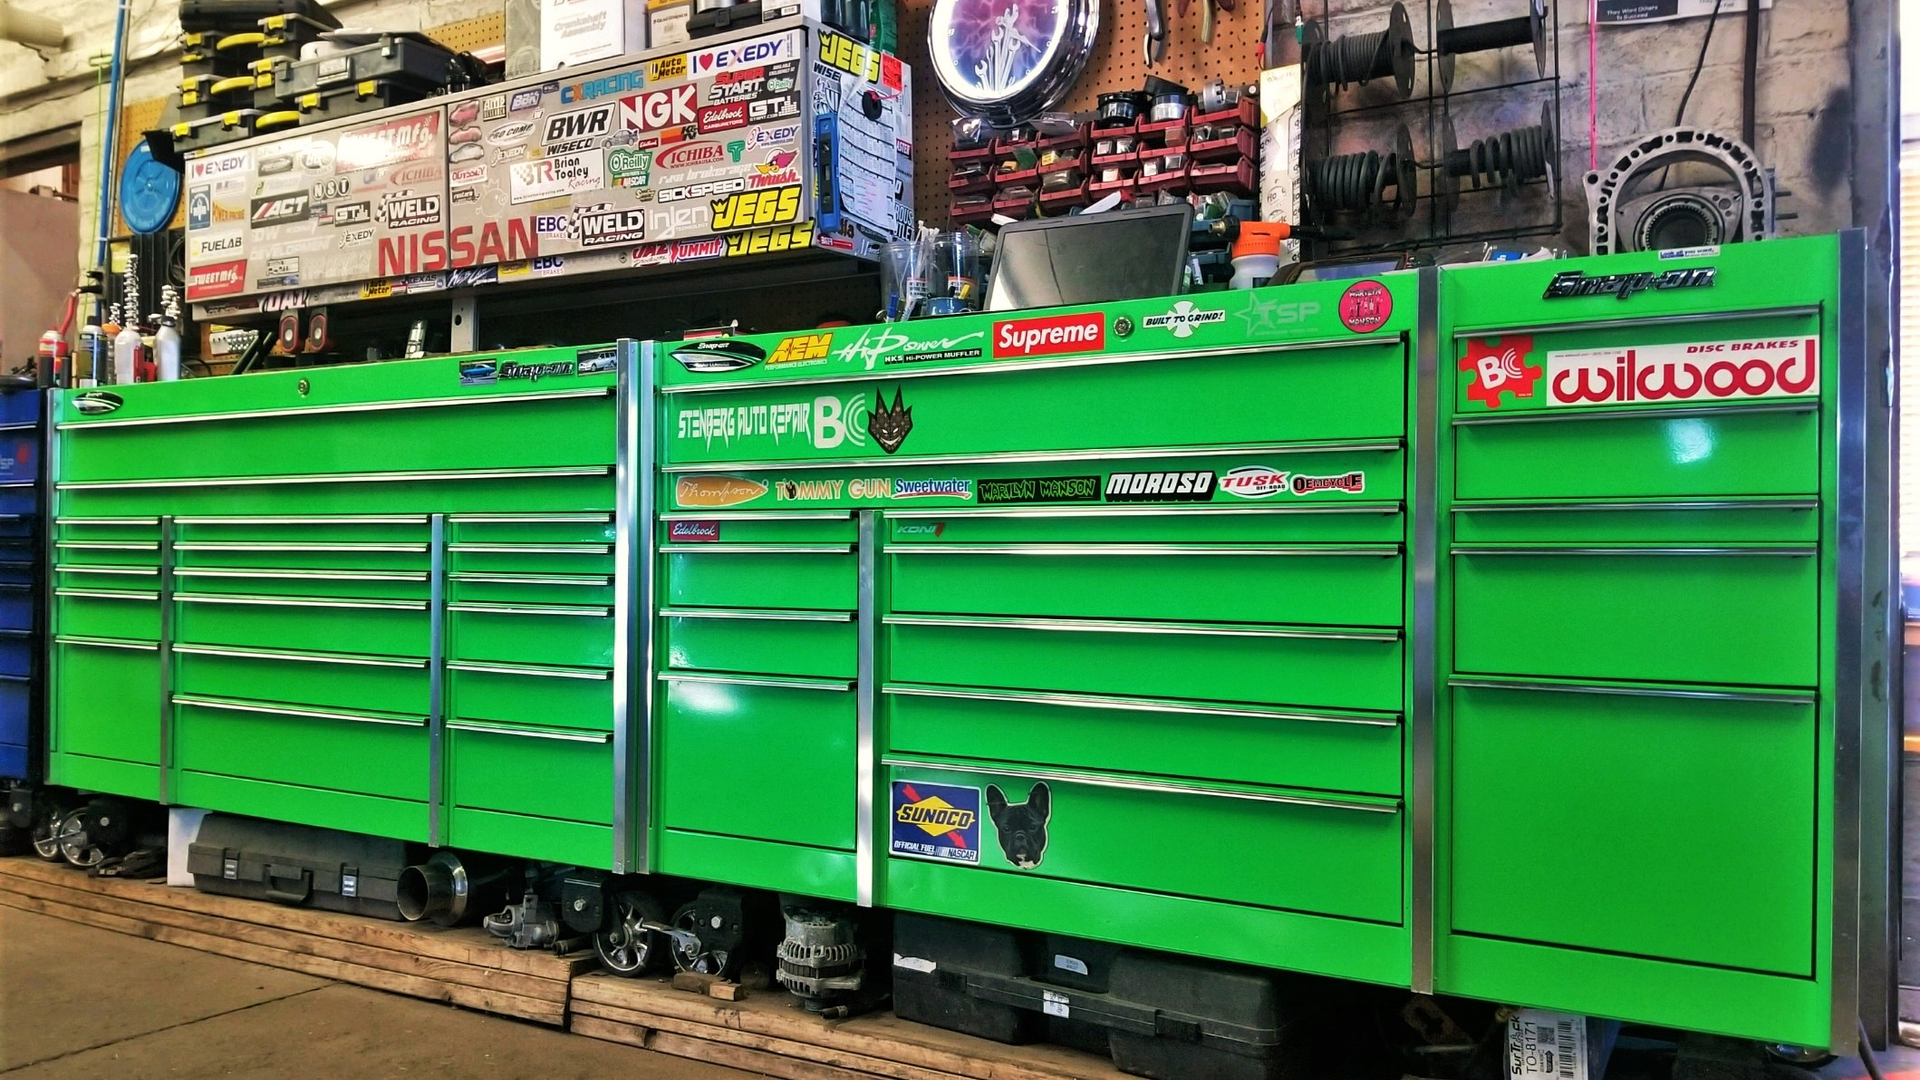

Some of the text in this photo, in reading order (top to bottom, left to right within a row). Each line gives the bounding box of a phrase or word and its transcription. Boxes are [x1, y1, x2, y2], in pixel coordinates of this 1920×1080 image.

[554, 10, 608, 32] Crankshaft
[560, 21, 606, 39] Assembly
[659, 57, 682, 69] Auto
[692, 56, 698, 74] I
[716, 38, 784, 68] EXEDY
[819, 32, 881, 84] JEGS
[658, 65, 687, 80] Meter
[715, 66, 765, 84] SUPER
[814, 62, 841, 82] WISE
[561, 69, 644, 104] CXRACING
[708, 78, 765, 100] START
[483, 94, 506, 111] AMP
[619, 84, 697, 132] NGK
[714, 92, 758, 106] BATTERIES
[702, 106, 743, 124] Edelbrock
[506, 123, 534, 138] COMP
[546, 108, 610, 142] BWR
[756, 126, 799, 142] EXEDY
[499, 144, 527, 160] EXEDY
[546, 138, 595, 156] WISECO
[671, 145, 724, 164] ICHIBA
[205, 155, 245, 175] EXEDY
[554, 156, 580, 170] Brian
[611, 152, 649, 172] O'Reilly
[401, 166, 443, 182] ICHIBA
[451, 166, 486, 181] ODYSSEY
[554, 166, 589, 180] Tooley
[686, 163, 753, 181] brokerage
[749, 168, 800, 189] Thrush
[568, 176, 601, 190] Racing
[658, 179, 744, 202] SICKSPEED
[264, 195, 309, 218] ACT
[388, 195, 440, 220] WELD
[712, 187, 801, 231] JEGS
[389, 215, 439, 228] RACING
[537, 216, 567, 232] EBC
[582, 211, 644, 236] WELD
[675, 223, 709, 232] TECHNOLOGY
[201, 236, 242, 253] FUELAB
[345, 229, 375, 242] EXEDY
[584, 232, 643, 245] RACING
[726, 222, 813, 257] JEGS
[378, 215, 539, 276] NISSAN
[671, 238, 721, 264] SUMMIT
[533, 256, 564, 270] EBC
[542, 268, 564, 276] BRAKES
[193, 273, 219, 286] SWEET
[1541, 266, 1717, 300] Snap-on
[368, 286, 389, 295] Meter
[1349, 288, 1383, 298] MARILYN
[1145, 310, 1223, 328] BUILT TO GRIND!
[1253, 300, 1322, 326] TSP
[1348, 316, 1382, 326] MANSON
[998, 321, 1099, 354] Supreme
[766, 332, 834, 364] AEM
[884, 355, 903, 364] HKS
[943, 349, 980, 359] MUFFLER
[1686, 340, 1800, 355] DISC BRAKES
[764, 358, 828, 371] PERFORMANCE ELECTRONICS
[1551, 339, 1816, 404] wilwood
[678, 405, 735, 453] STENBERG
[737, 405, 767, 441] AUTO
[769, 402, 812, 446] REPAIR
[775, 478, 892, 501] TOMMY GUN
[894, 478, 971, 495] Sweetwater
[978, 478, 1097, 501] MARILYN MANSON
[1106, 473, 1214, 496] MOROSO
[1222, 474, 1287, 488] TUSK
[672, 522, 717, 537] Edelbrock
[897, 525, 936, 534] KONI
[900, 805, 972, 828] SUNOCO
[893, 840, 976, 860] OFFICIAL FUEL NASCAR
[1524, 1021, 1538, 1075] TO-8171
